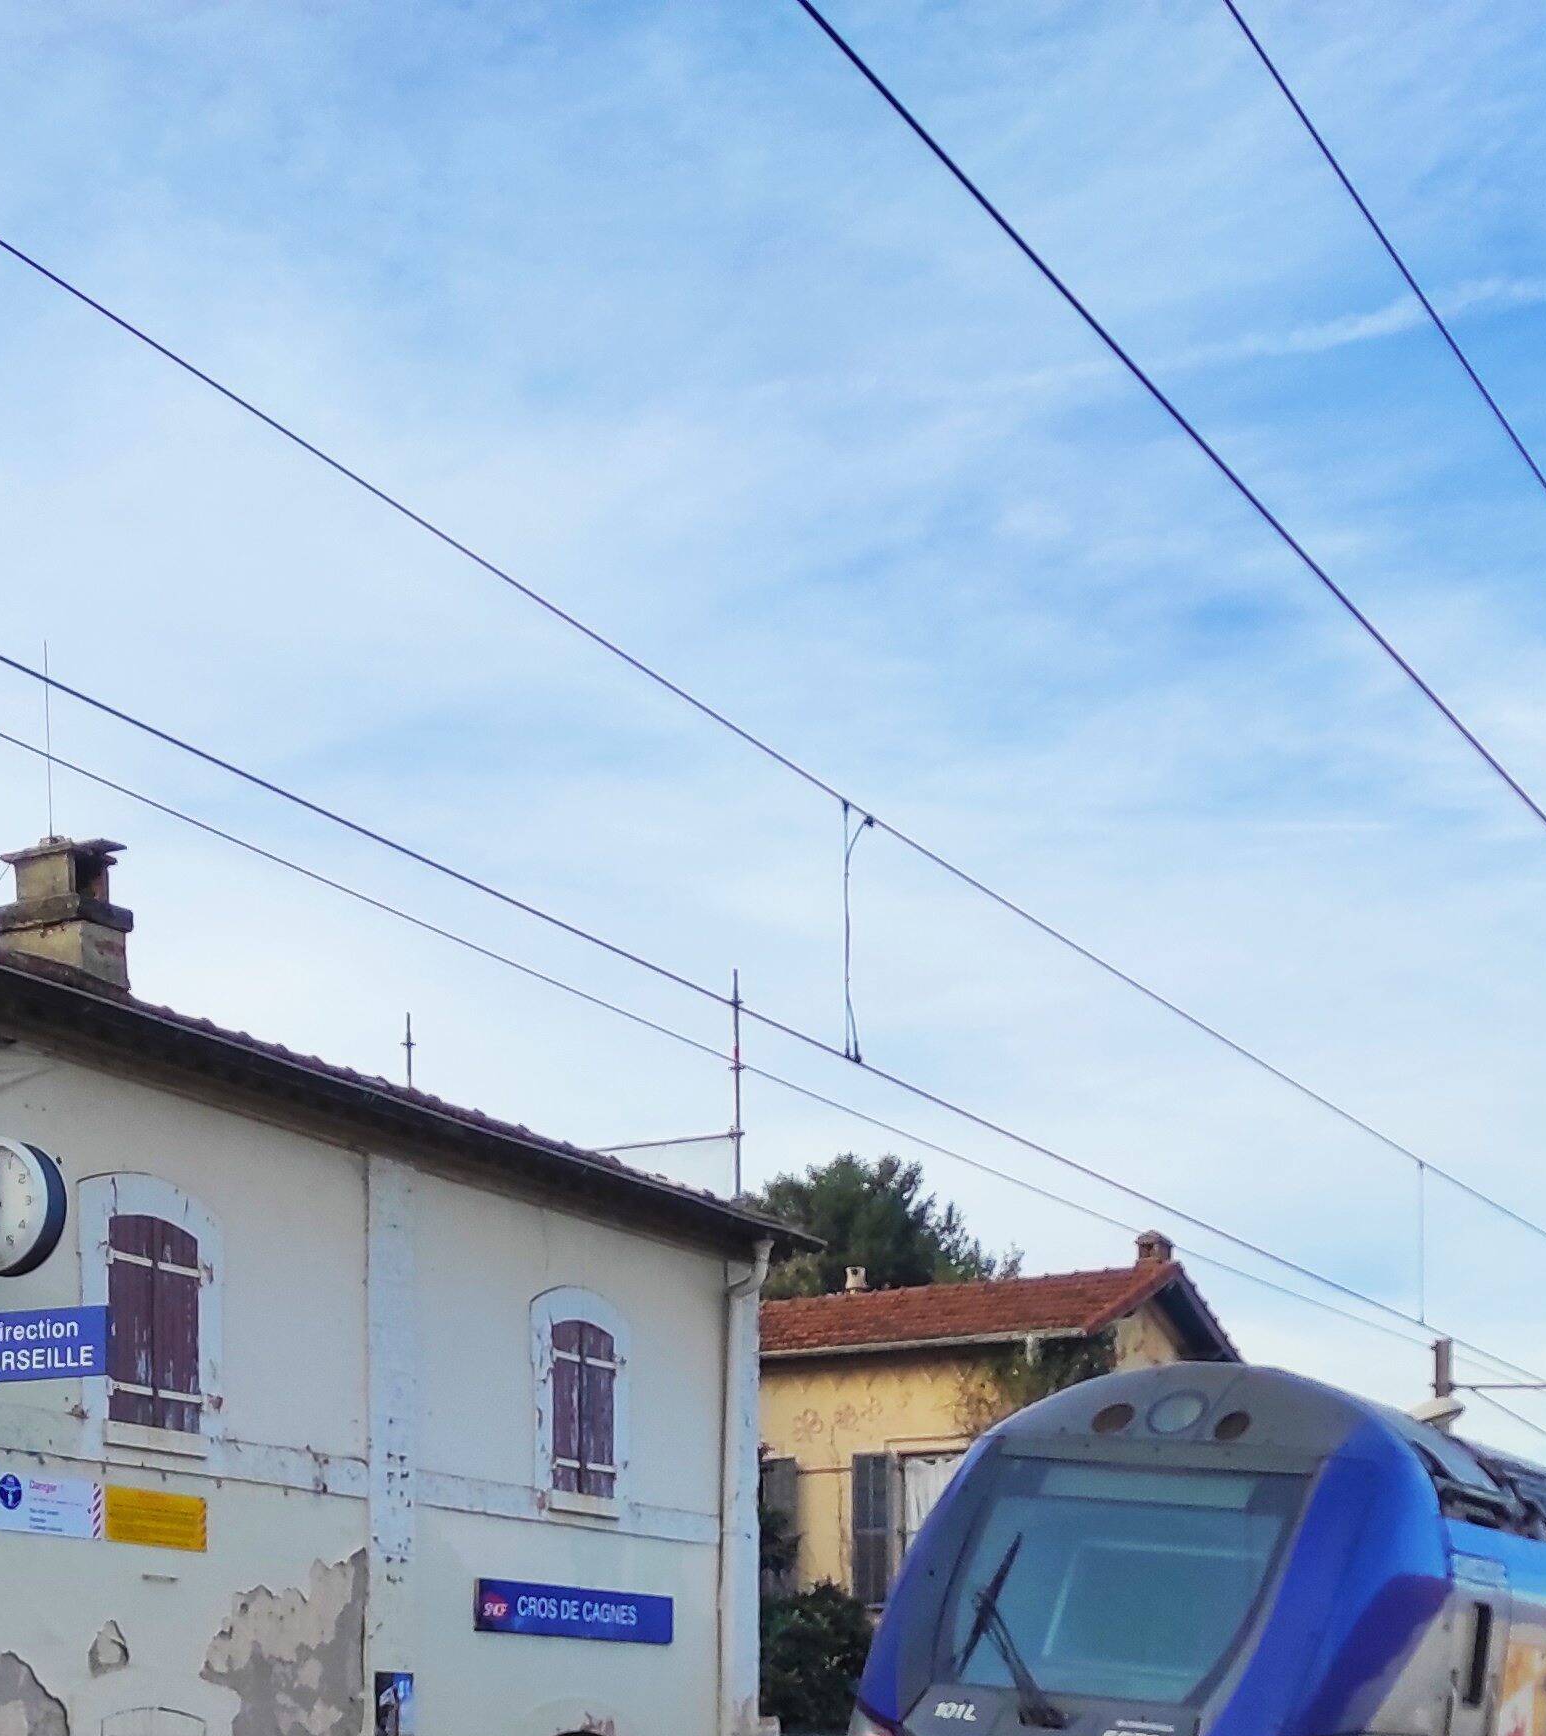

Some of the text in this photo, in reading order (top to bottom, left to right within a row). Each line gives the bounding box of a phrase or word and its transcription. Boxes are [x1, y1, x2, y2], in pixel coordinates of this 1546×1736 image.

[516, 1594, 559, 1620] CROS
[560, 1599, 580, 1622] DE
[582, 1600, 638, 1627] CAGNES
